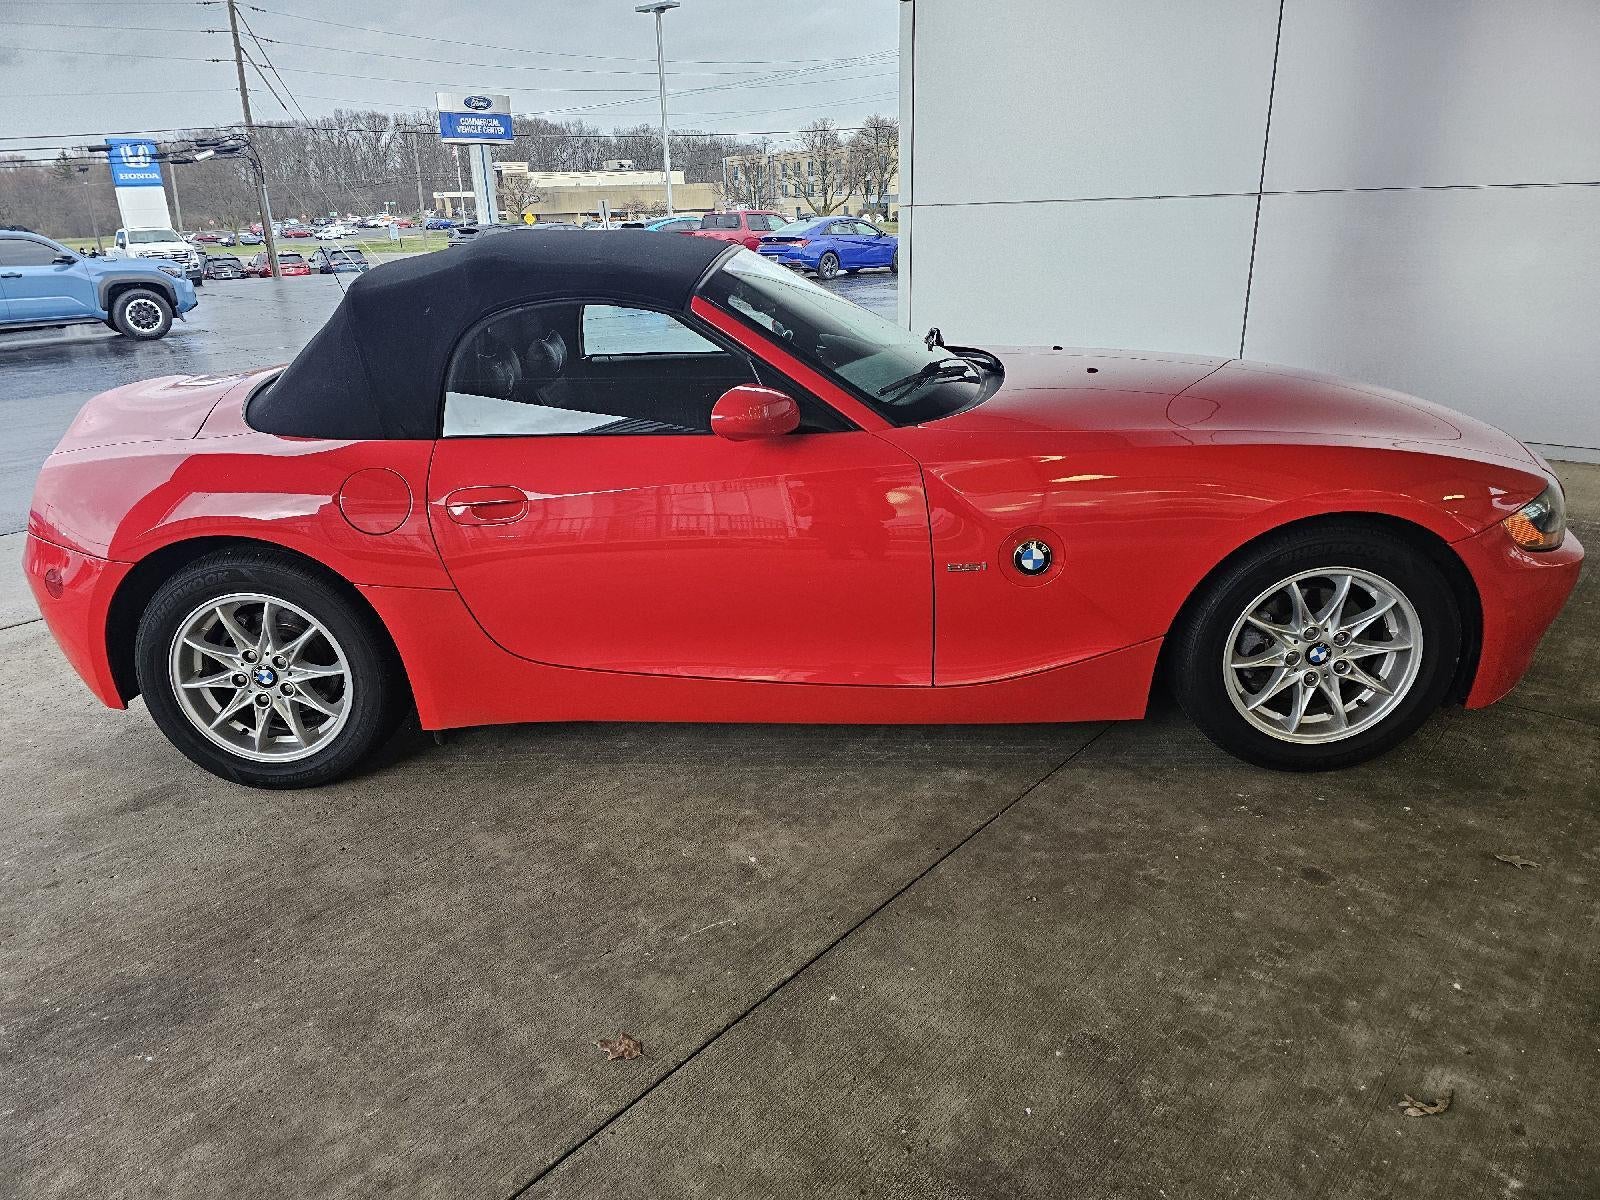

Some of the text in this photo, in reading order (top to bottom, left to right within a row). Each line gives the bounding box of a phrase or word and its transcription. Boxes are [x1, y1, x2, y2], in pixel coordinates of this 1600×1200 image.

[460, 118, 501, 127] COMMERCIAL
[456, 125, 505, 135] VEHICLE CENTER
